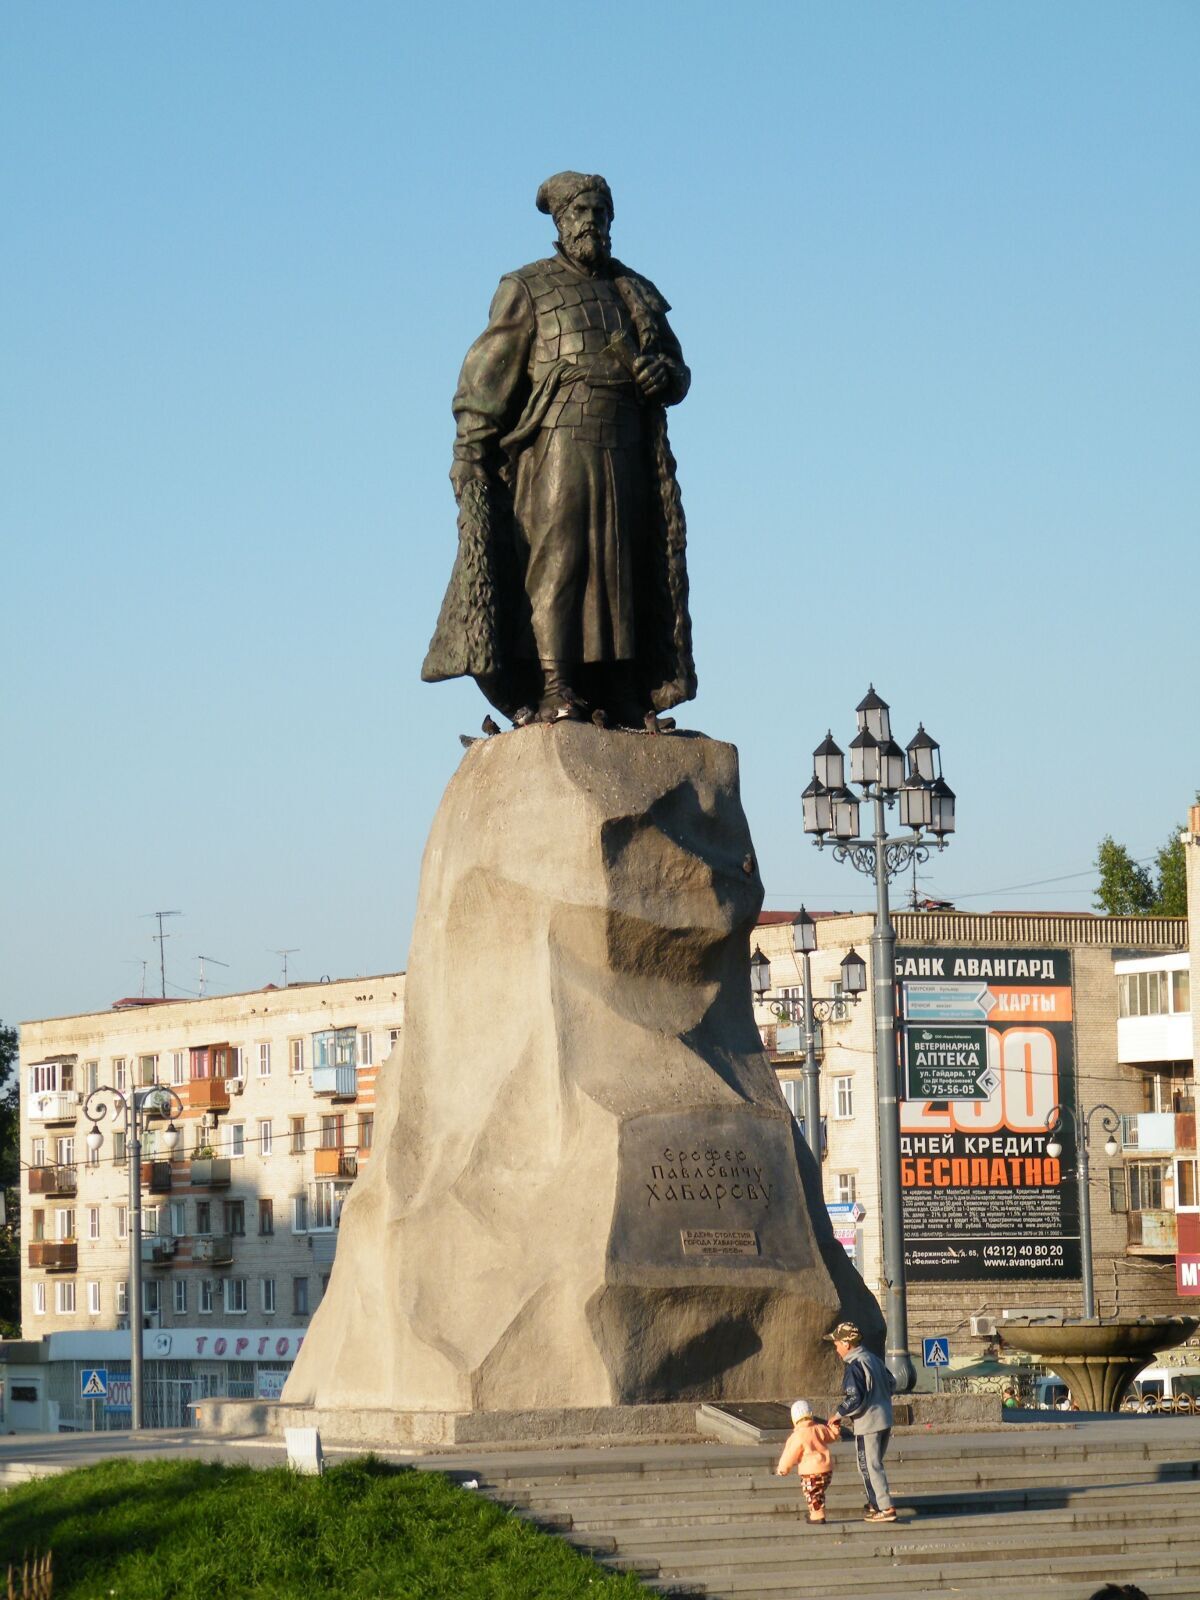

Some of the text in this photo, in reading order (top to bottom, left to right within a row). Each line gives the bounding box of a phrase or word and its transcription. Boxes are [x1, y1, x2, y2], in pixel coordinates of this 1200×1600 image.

[894, 958, 1055, 980] БАНК АВАНГАРД
[998, 992, 1056, 1012] КАРТЫ
[914, 1042, 980, 1050] ВЕТЕРИНАРНАЯ
[916, 1052, 980, 1066] АПТЕКА
[932, 1070, 965, 1078] Гайдара,
[932, 1085, 974, 1094] 75-56-05
[900, 1134, 1053, 1156] ДНЕЙ КРЕДИТ
[901, 1157, 1061, 1187] БЕСПЛАТНО
[983, 1246, 1016, 1256] (4212)
[1020, 1246, 1032, 1256] 40
[1034, 1246, 1047, 1256] 80
[1050, 1246, 1063, 1256] 20
[984, 1258, 1064, 1268] www.avangard.ru
